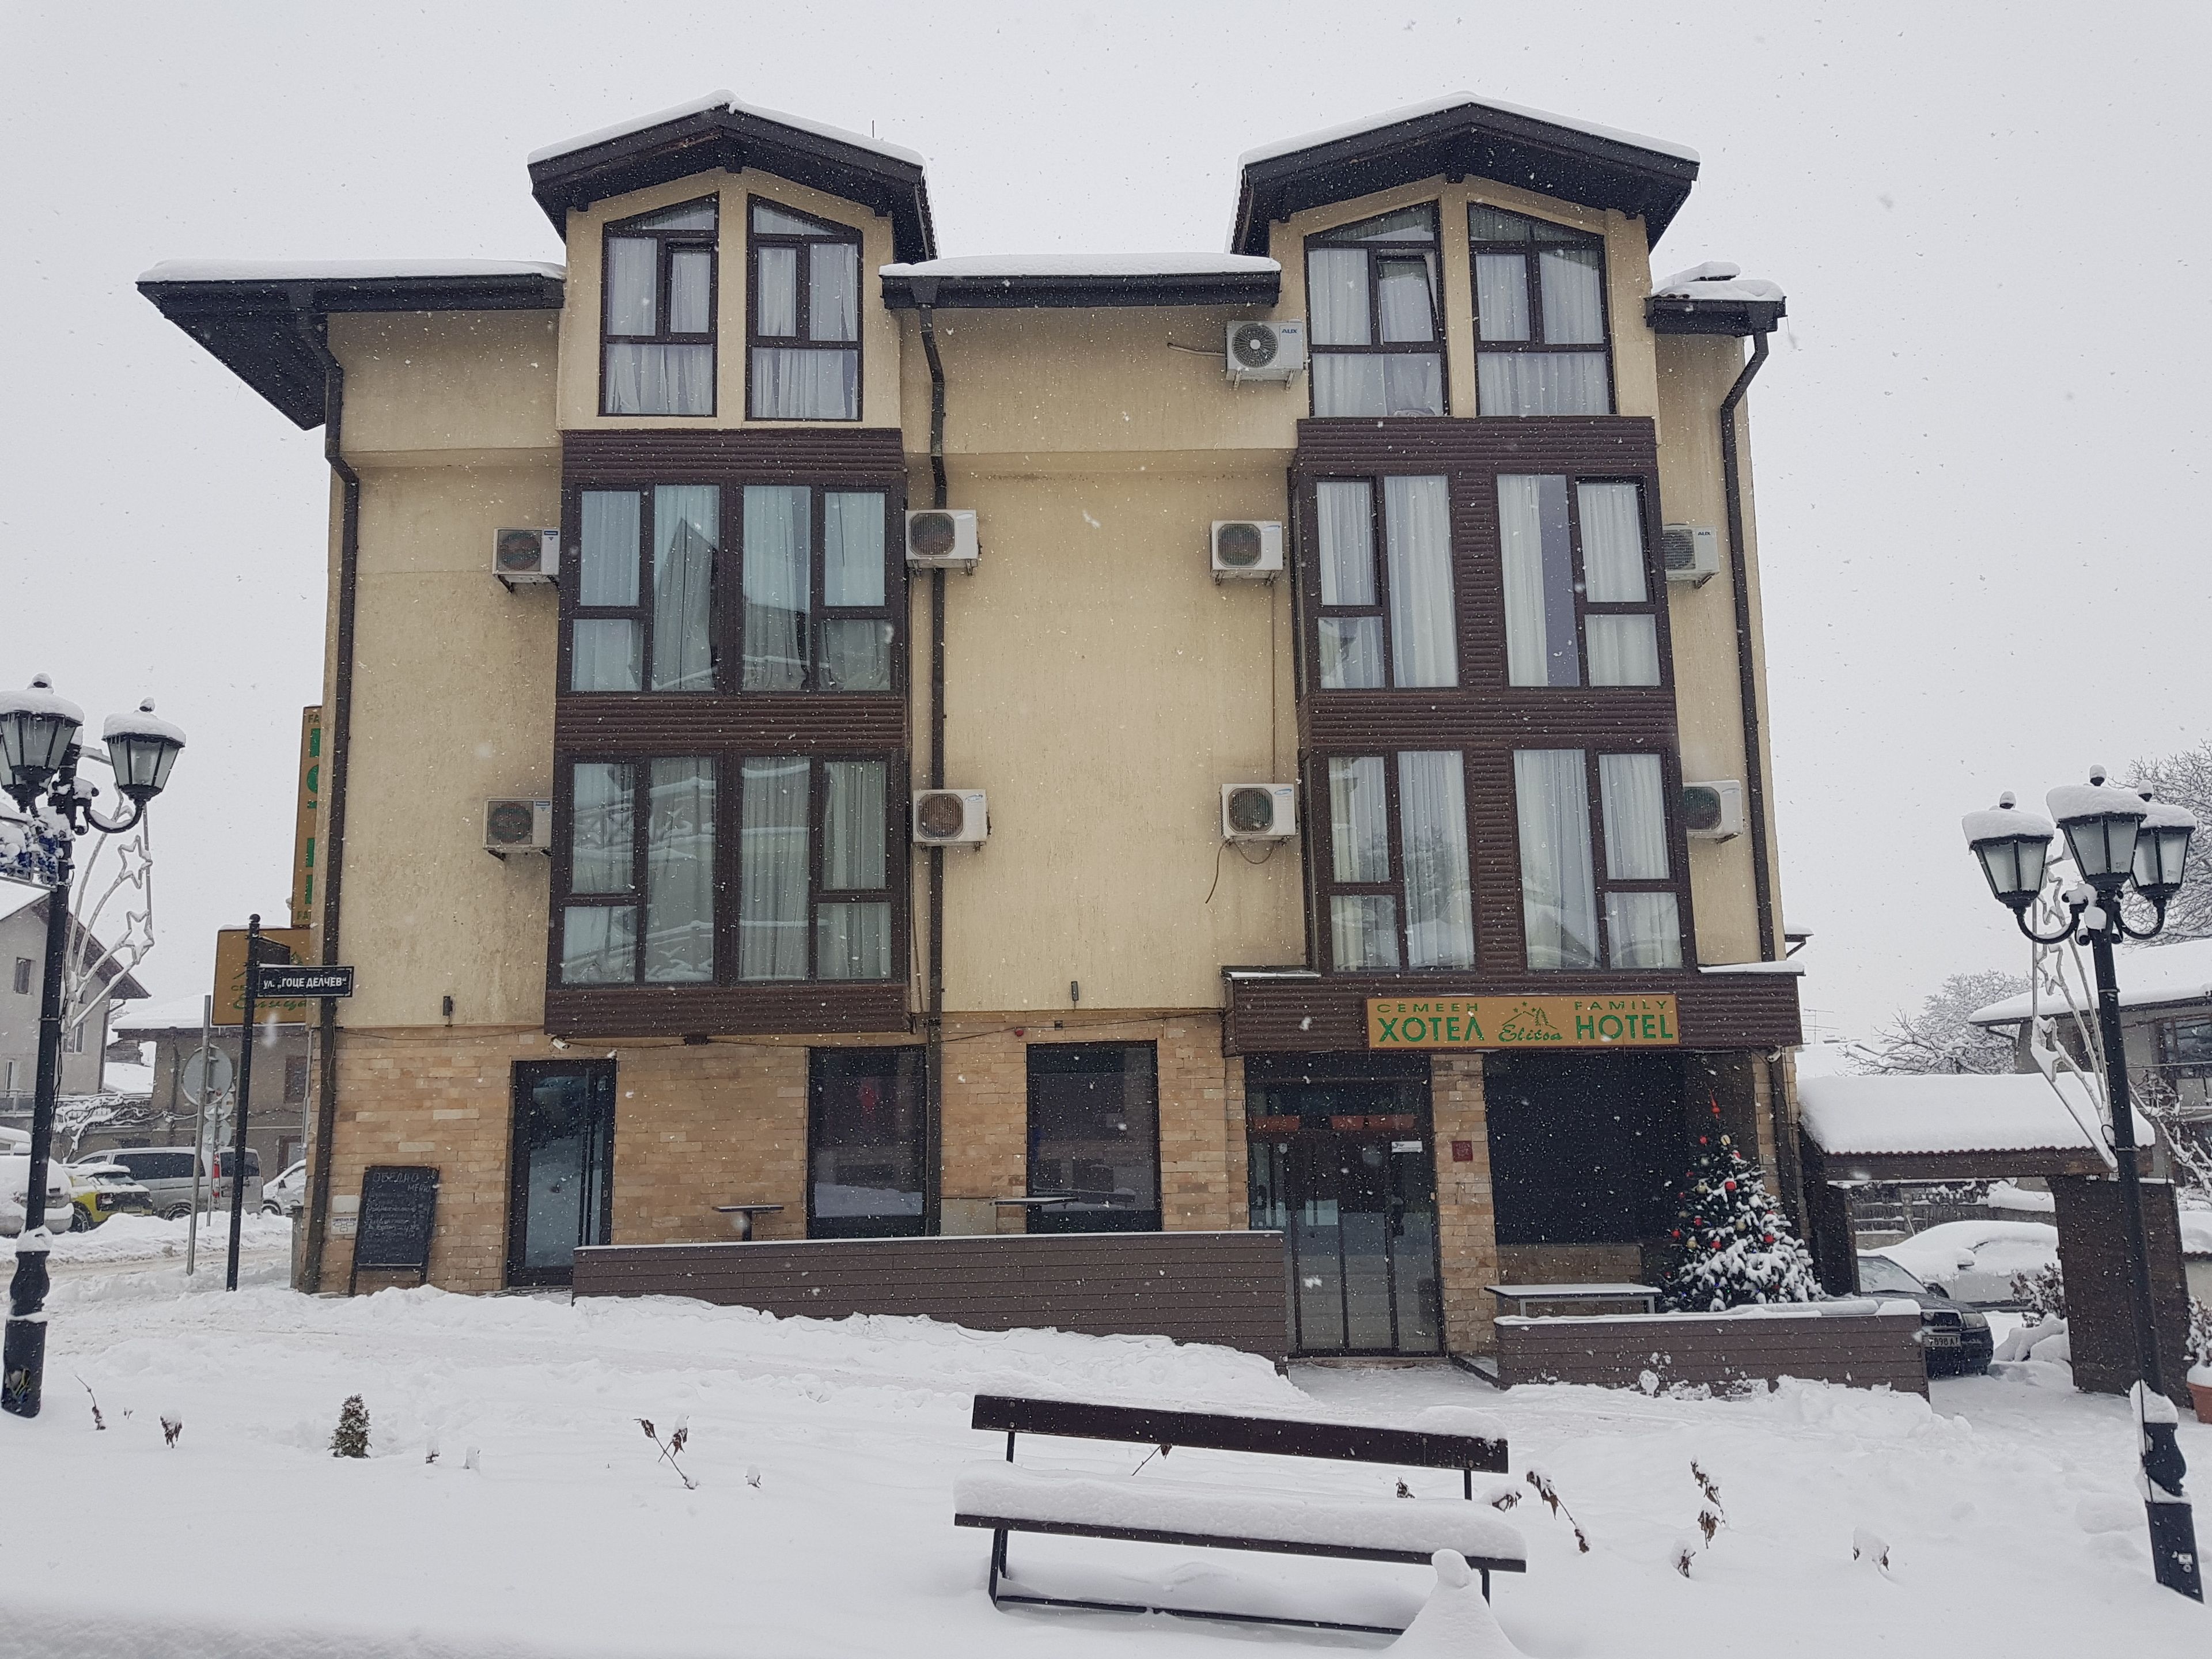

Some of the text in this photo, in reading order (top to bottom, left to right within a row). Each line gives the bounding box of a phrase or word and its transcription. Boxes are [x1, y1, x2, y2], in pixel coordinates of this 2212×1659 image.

[263, 980, 275, 990] ул.
[1377, 1002, 1478, 1013] СЕМЕЕН
[1574, 1001, 1667, 1011] FAMILY
[1377, 1017, 1484, 1042] ХОТЕЛ
[1575, 1014, 1673, 1040] HOTEL
